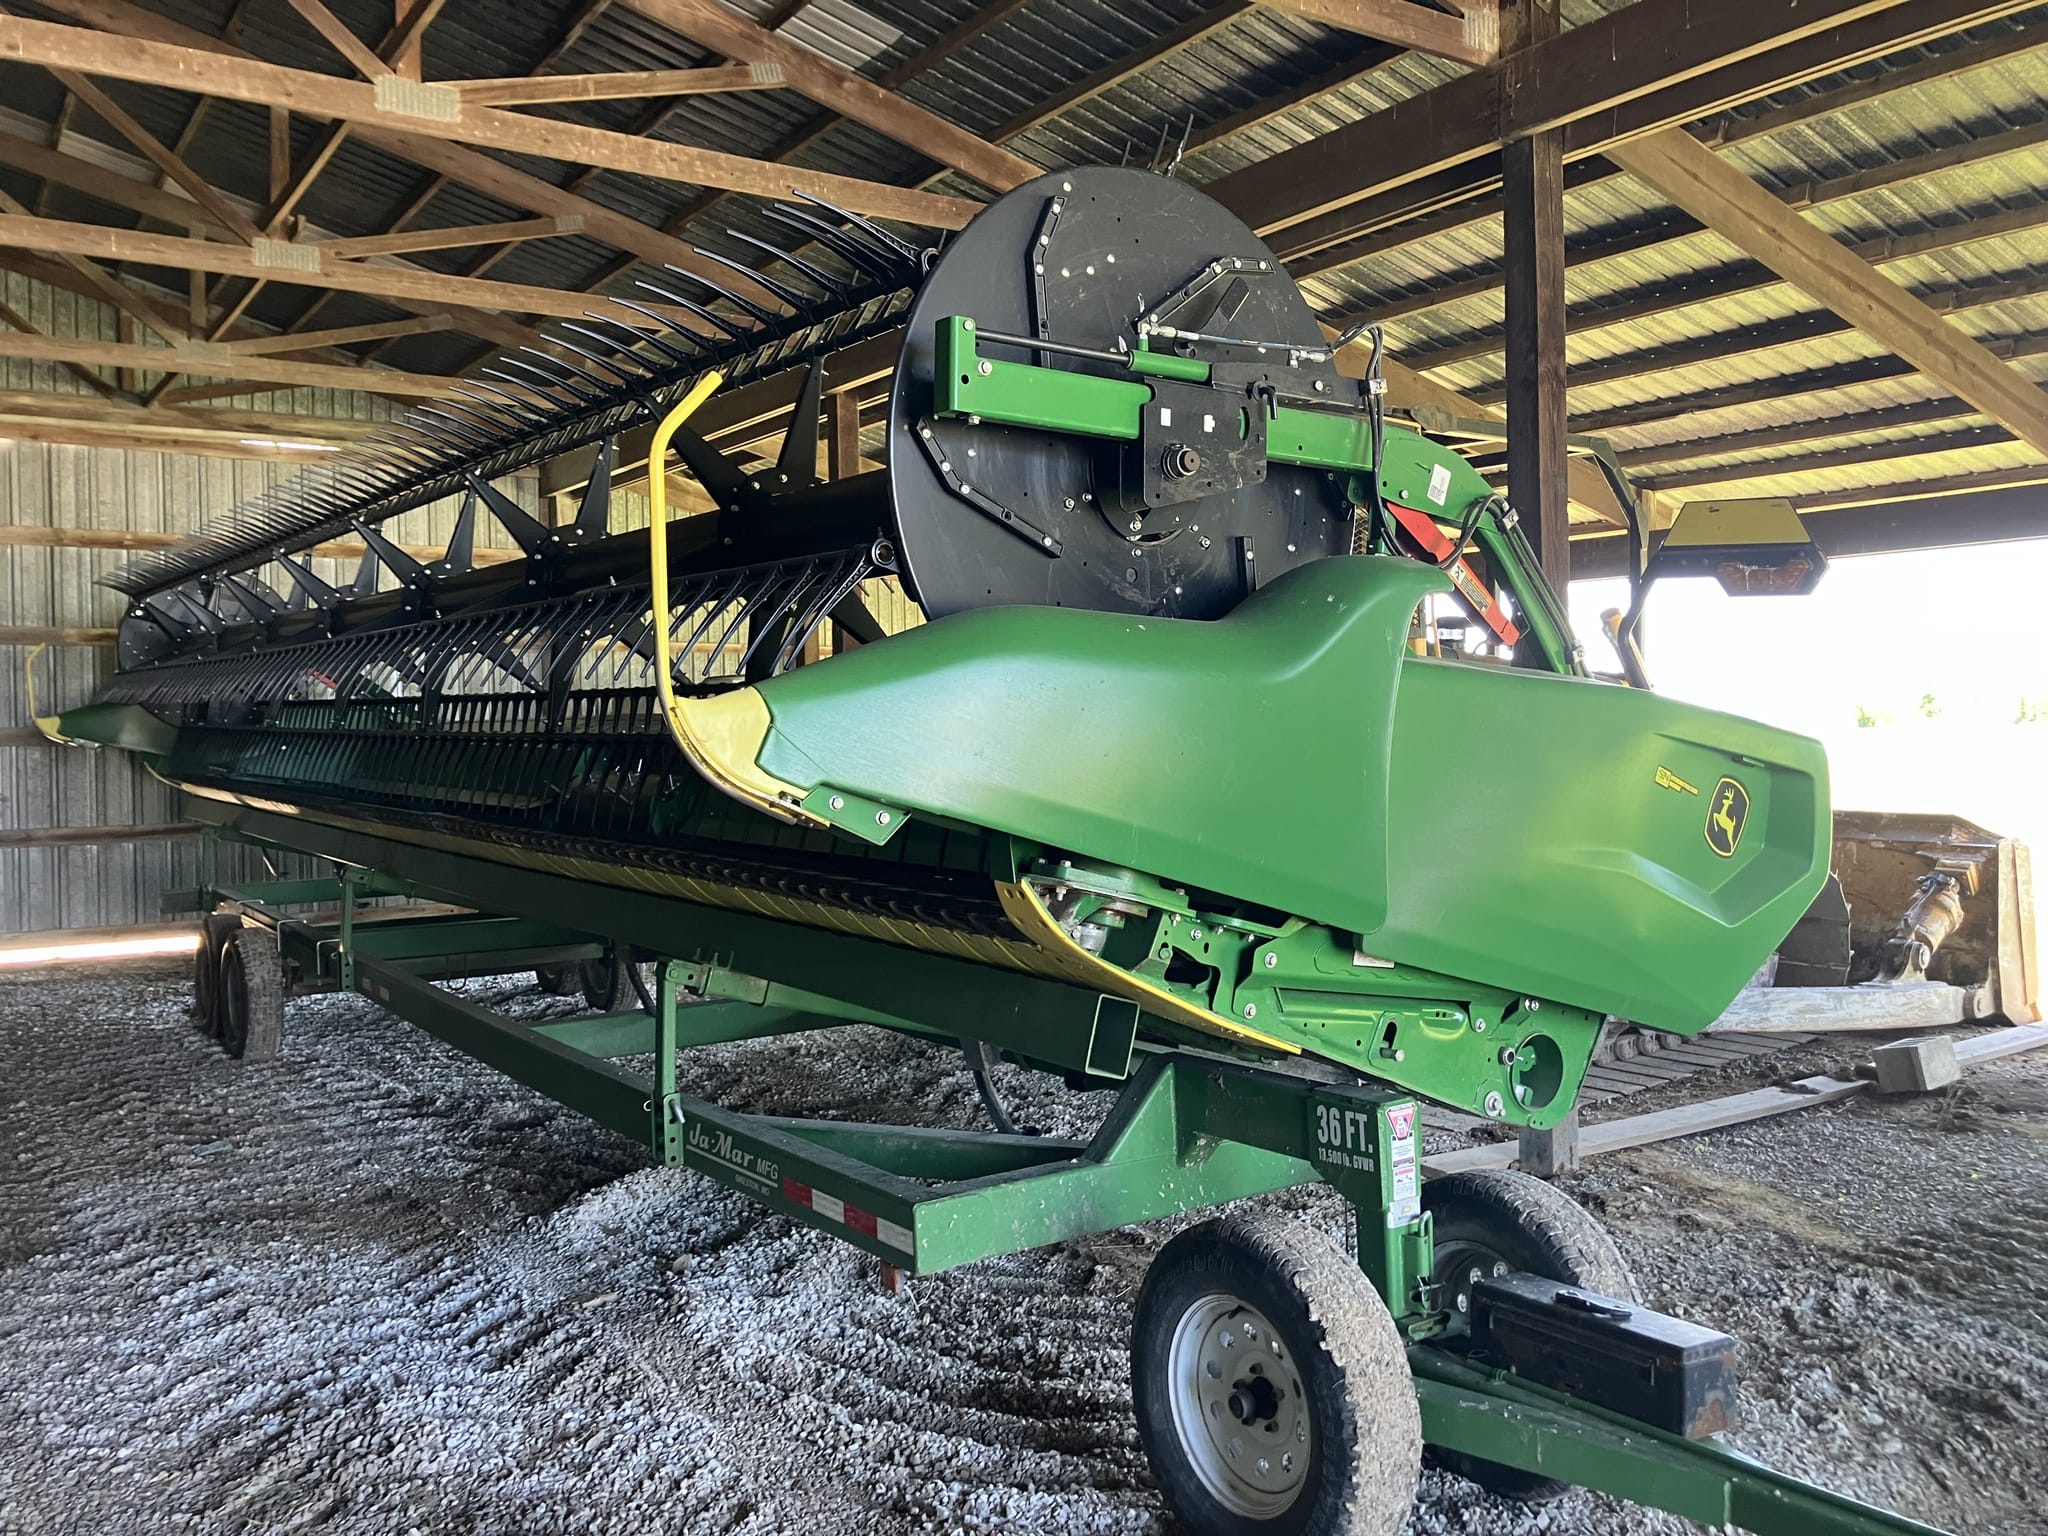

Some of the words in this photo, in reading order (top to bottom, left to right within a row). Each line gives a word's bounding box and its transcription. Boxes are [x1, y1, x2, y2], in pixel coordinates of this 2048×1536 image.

[1316, 1105, 1341, 1146] 36
[1345, 1110, 1373, 1153] FT.
[756, 1158, 779, 1180] MFG
[1318, 1146, 1342, 1164] 13,500
[1353, 1154, 1374, 1172] GVWR
